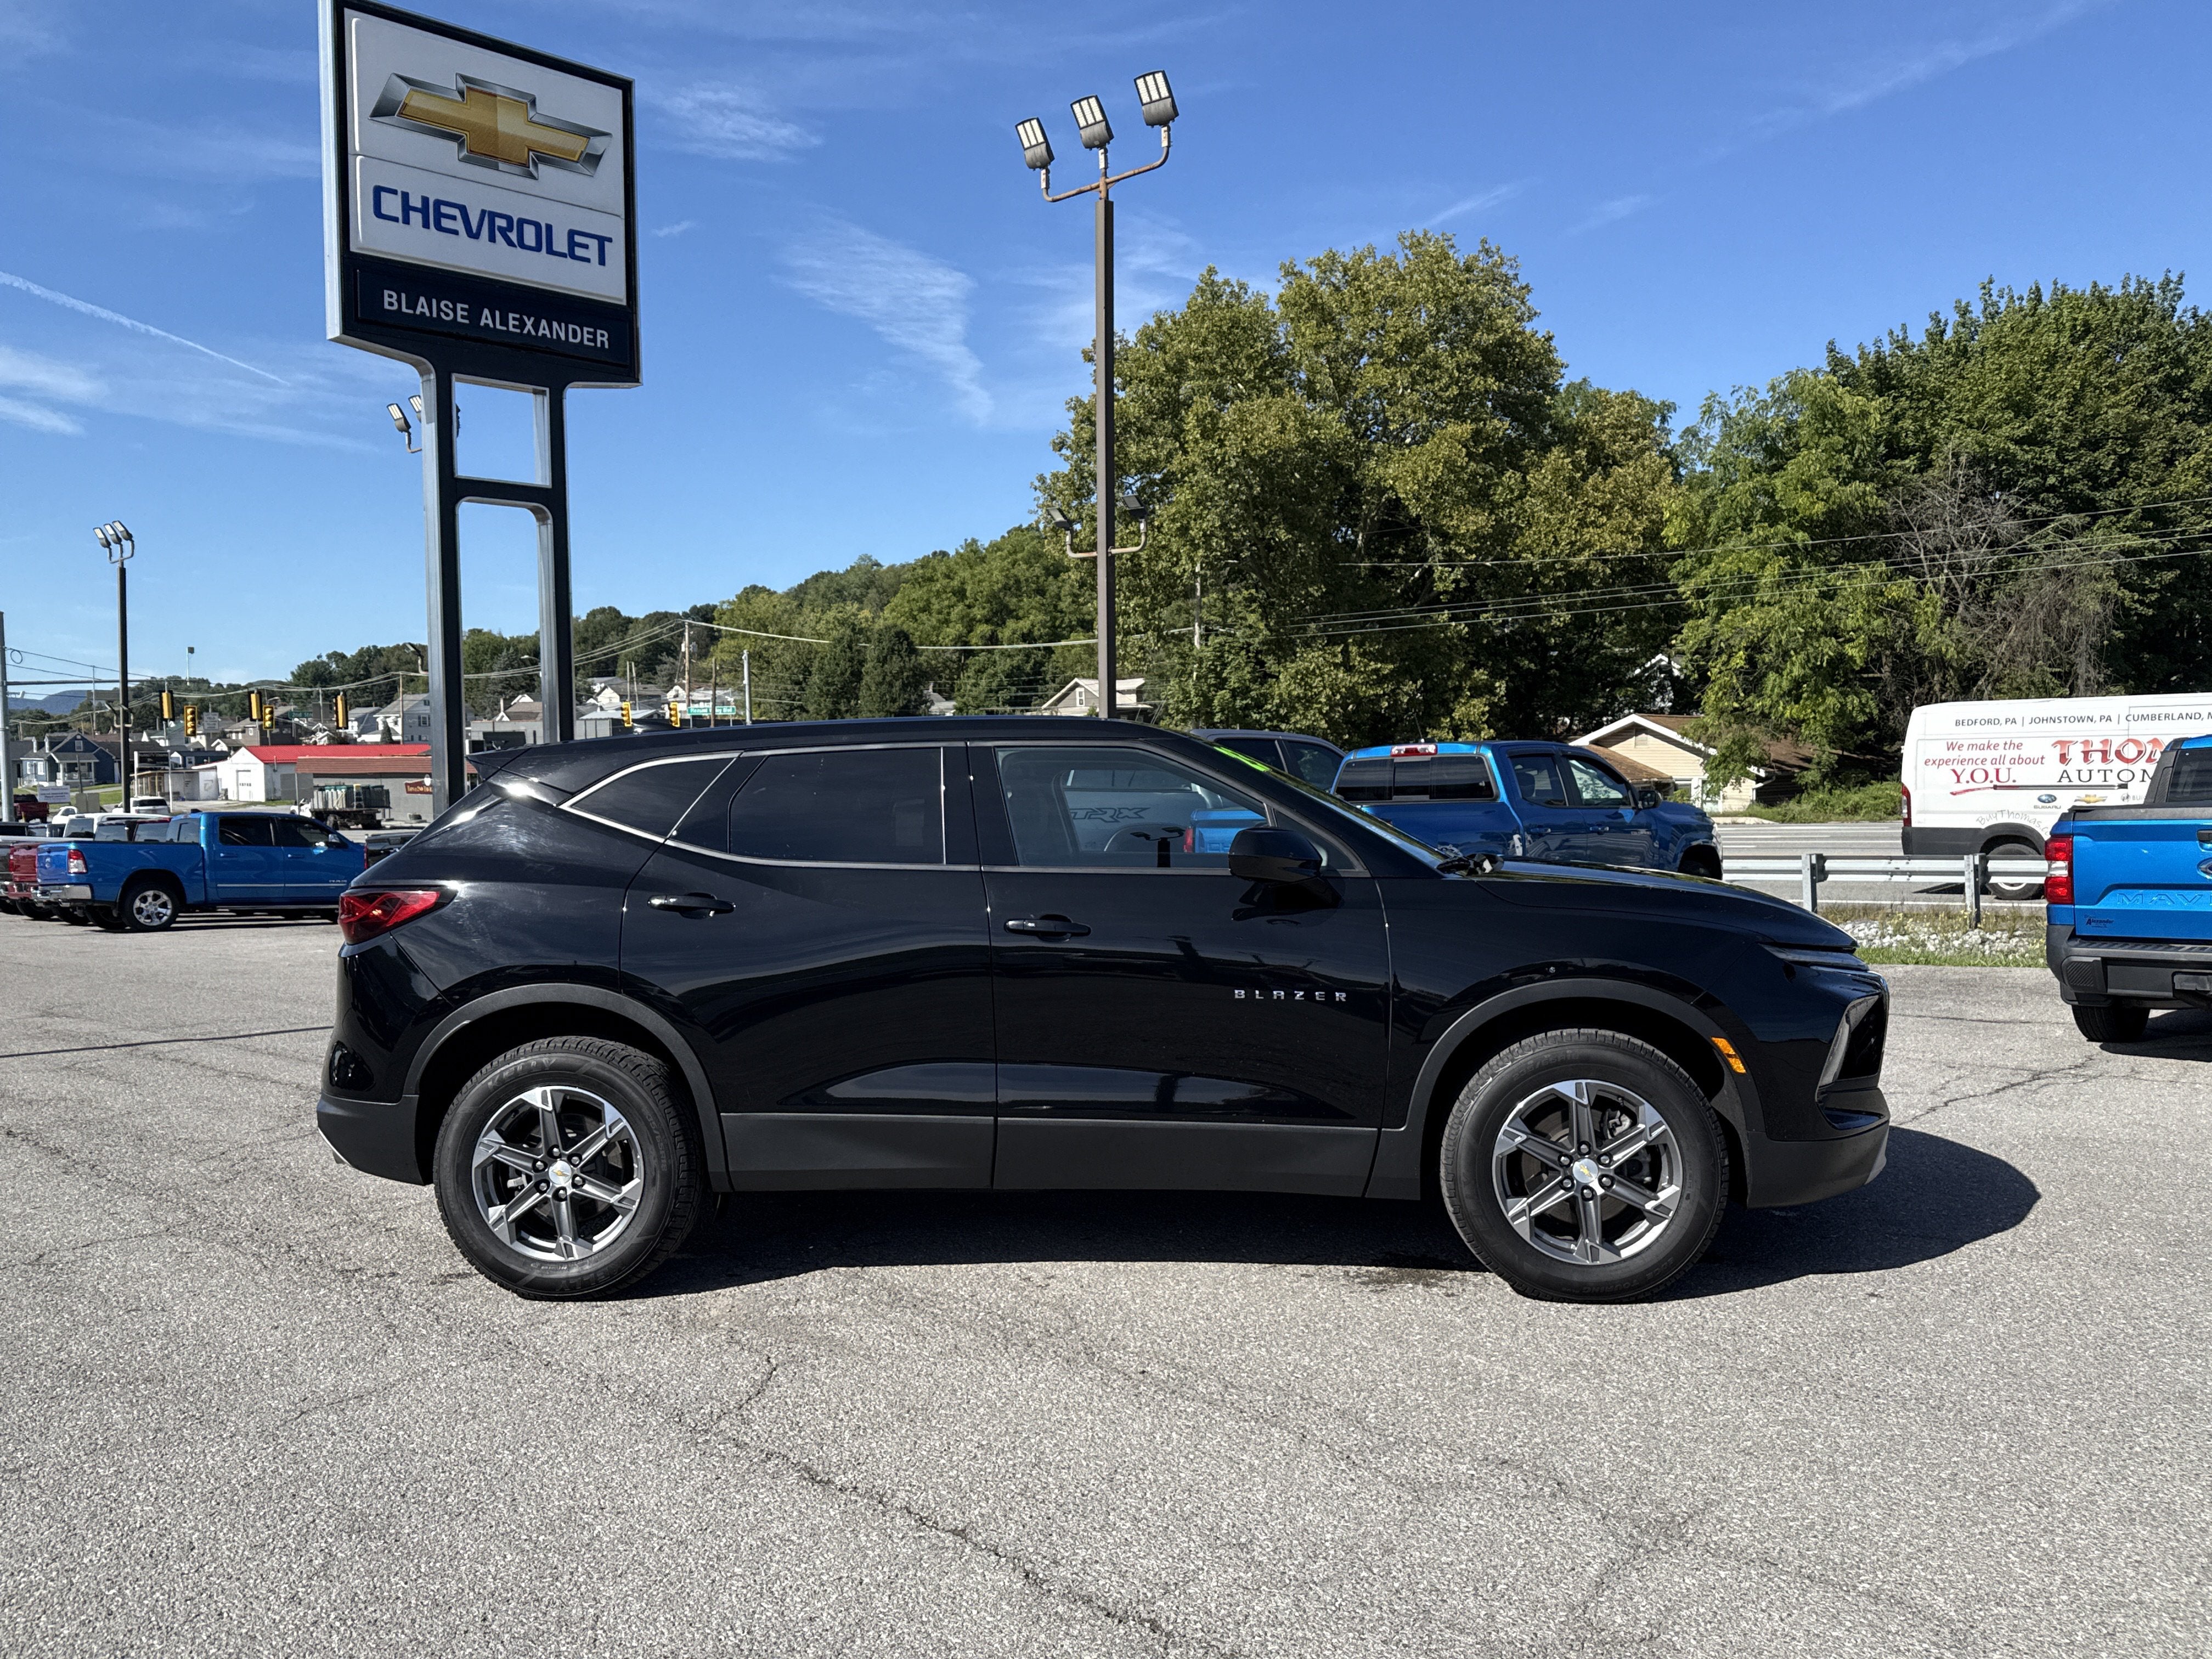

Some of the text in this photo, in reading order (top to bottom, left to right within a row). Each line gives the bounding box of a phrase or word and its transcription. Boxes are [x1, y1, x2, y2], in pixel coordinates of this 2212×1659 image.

[373, 184, 613, 266] CHEVROLET
[383, 289, 609, 349] BLAISE ALEXANDER
[1955, 718, 2002, 726] BEDFORD,
[2005, 717, 2017, 725] PA
[2029, 715, 2097, 725] JOHNSTOWN,
[2099, 714, 2112, 723] PA
[2125, 712, 2204, 722] CUMBERLAND,
[1946, 739, 2023, 751] We make the
[1924, 754, 2045, 769] experience all about
[1950, 768, 2017, 783] Y.O.U.
[1070, 807, 1151, 823] TRX
[2117, 893, 2212, 905] MAV
[1234, 989, 1346, 1001] BLAZER
[488, 1057, 557, 1089] KELLY
[642, 1107, 668, 1172] 35/65R18
